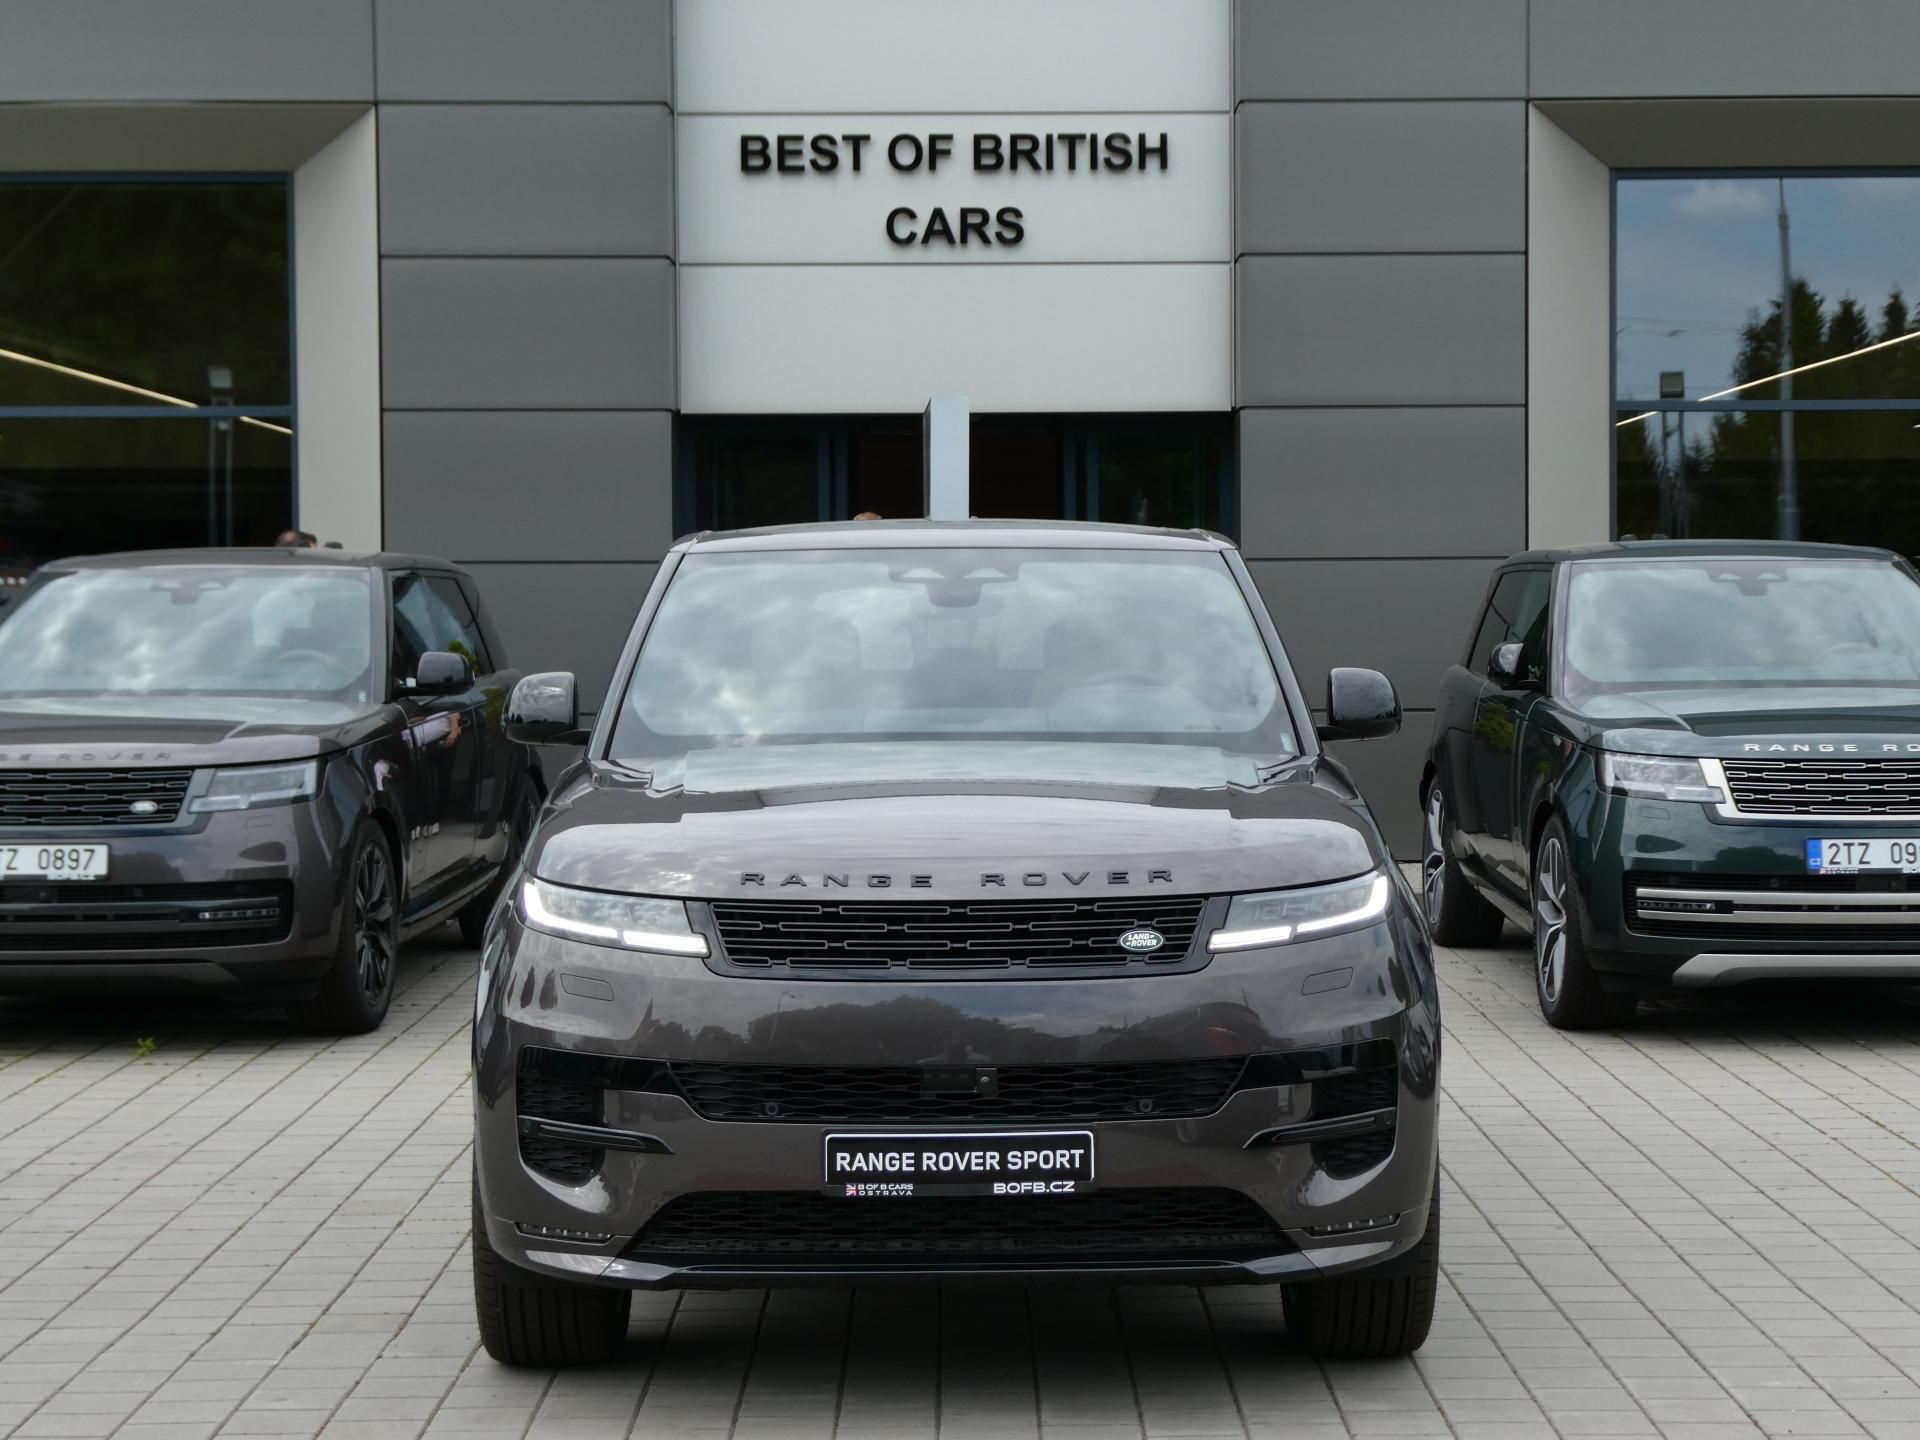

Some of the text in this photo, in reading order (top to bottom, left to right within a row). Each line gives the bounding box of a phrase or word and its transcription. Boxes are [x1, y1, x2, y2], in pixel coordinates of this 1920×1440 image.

[740, 132, 1168, 172] BEST OF BRITISH
[886, 207, 1024, 245] CARS
[56, 752, 171, 761] ROVER
[1743, 743, 1920, 752] RANGE RO
[38, 848, 95, 870] 0897
[1828, 842, 1920, 865] 2TZ 09
[740, 869, 1172, 888] RANGE ROVER
[1128, 933, 1150, 941] LAND
[836, 1149, 1084, 1171] RANGE ROVER SPORT
[994, 1181, 1075, 1194] BOFB.CZ
